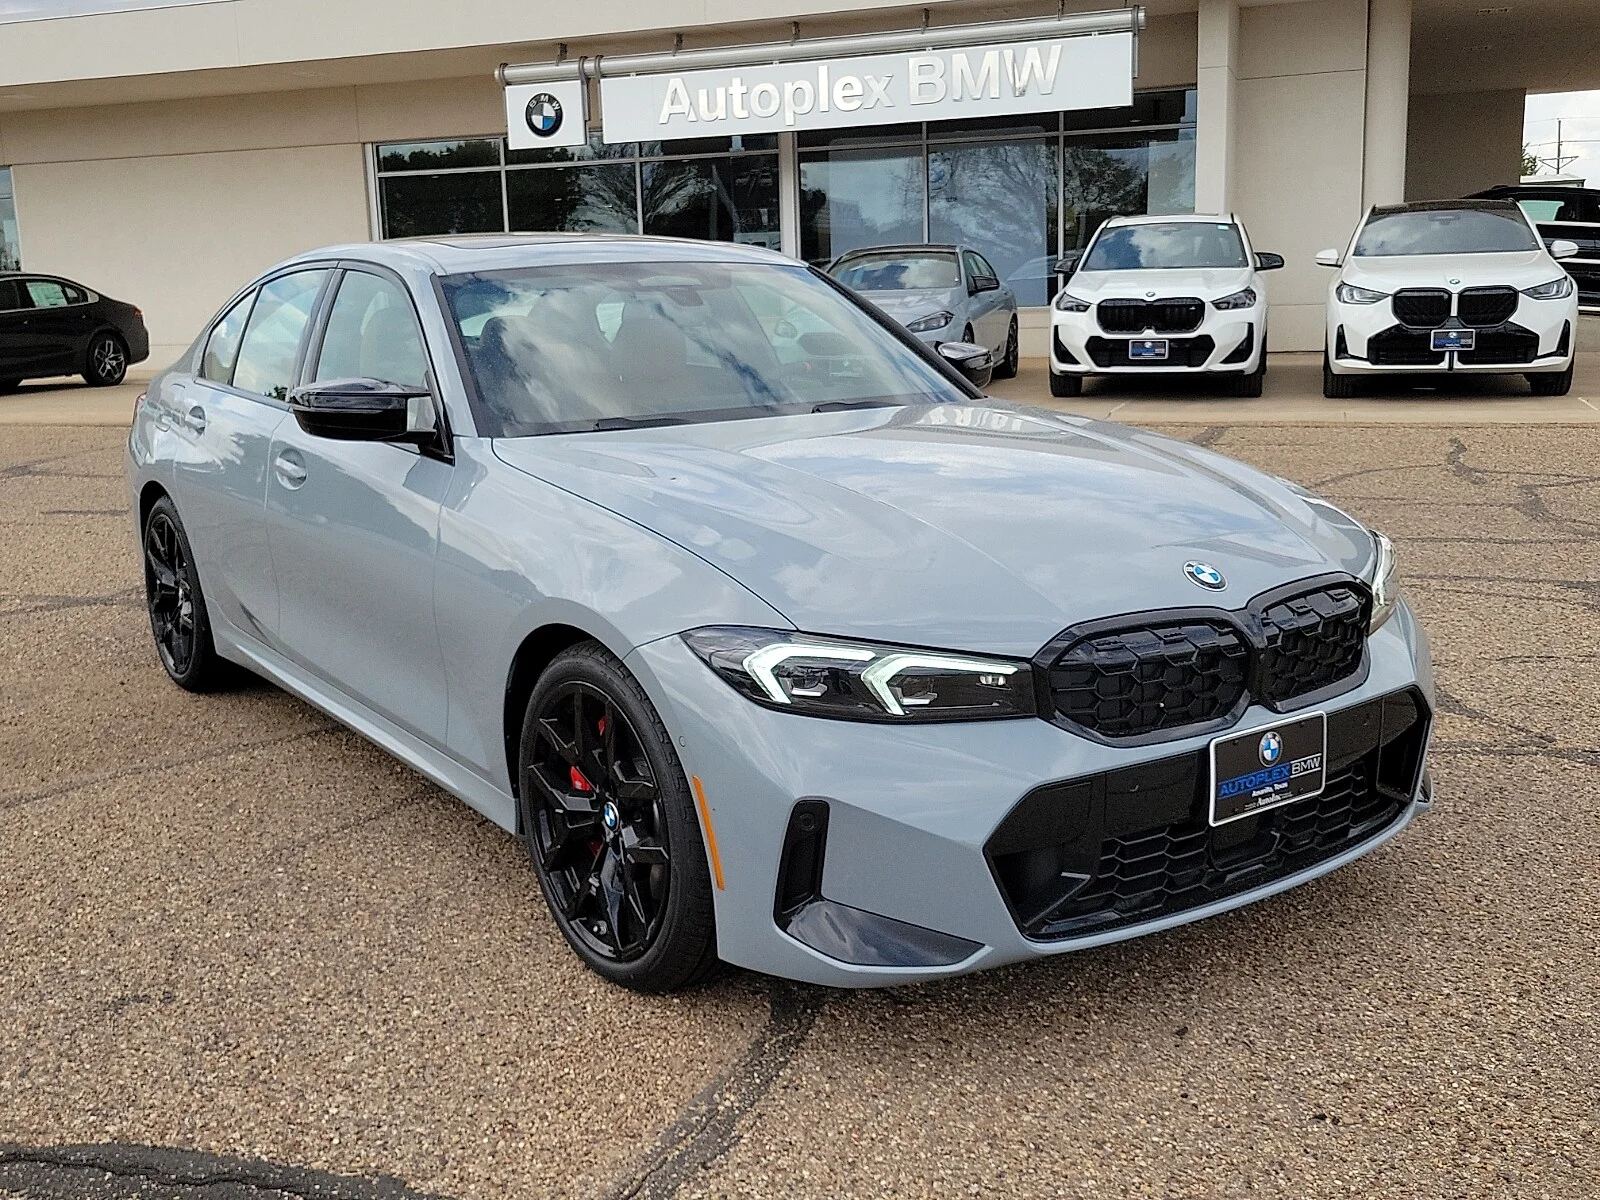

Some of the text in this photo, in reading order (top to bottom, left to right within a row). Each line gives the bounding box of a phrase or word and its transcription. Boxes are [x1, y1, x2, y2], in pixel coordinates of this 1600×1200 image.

[528, 94, 561, 111] BMW
[659, 45, 1062, 126] Autoplex BMW
[1220, 756, 1321, 796] AUTOPLEX BMW
